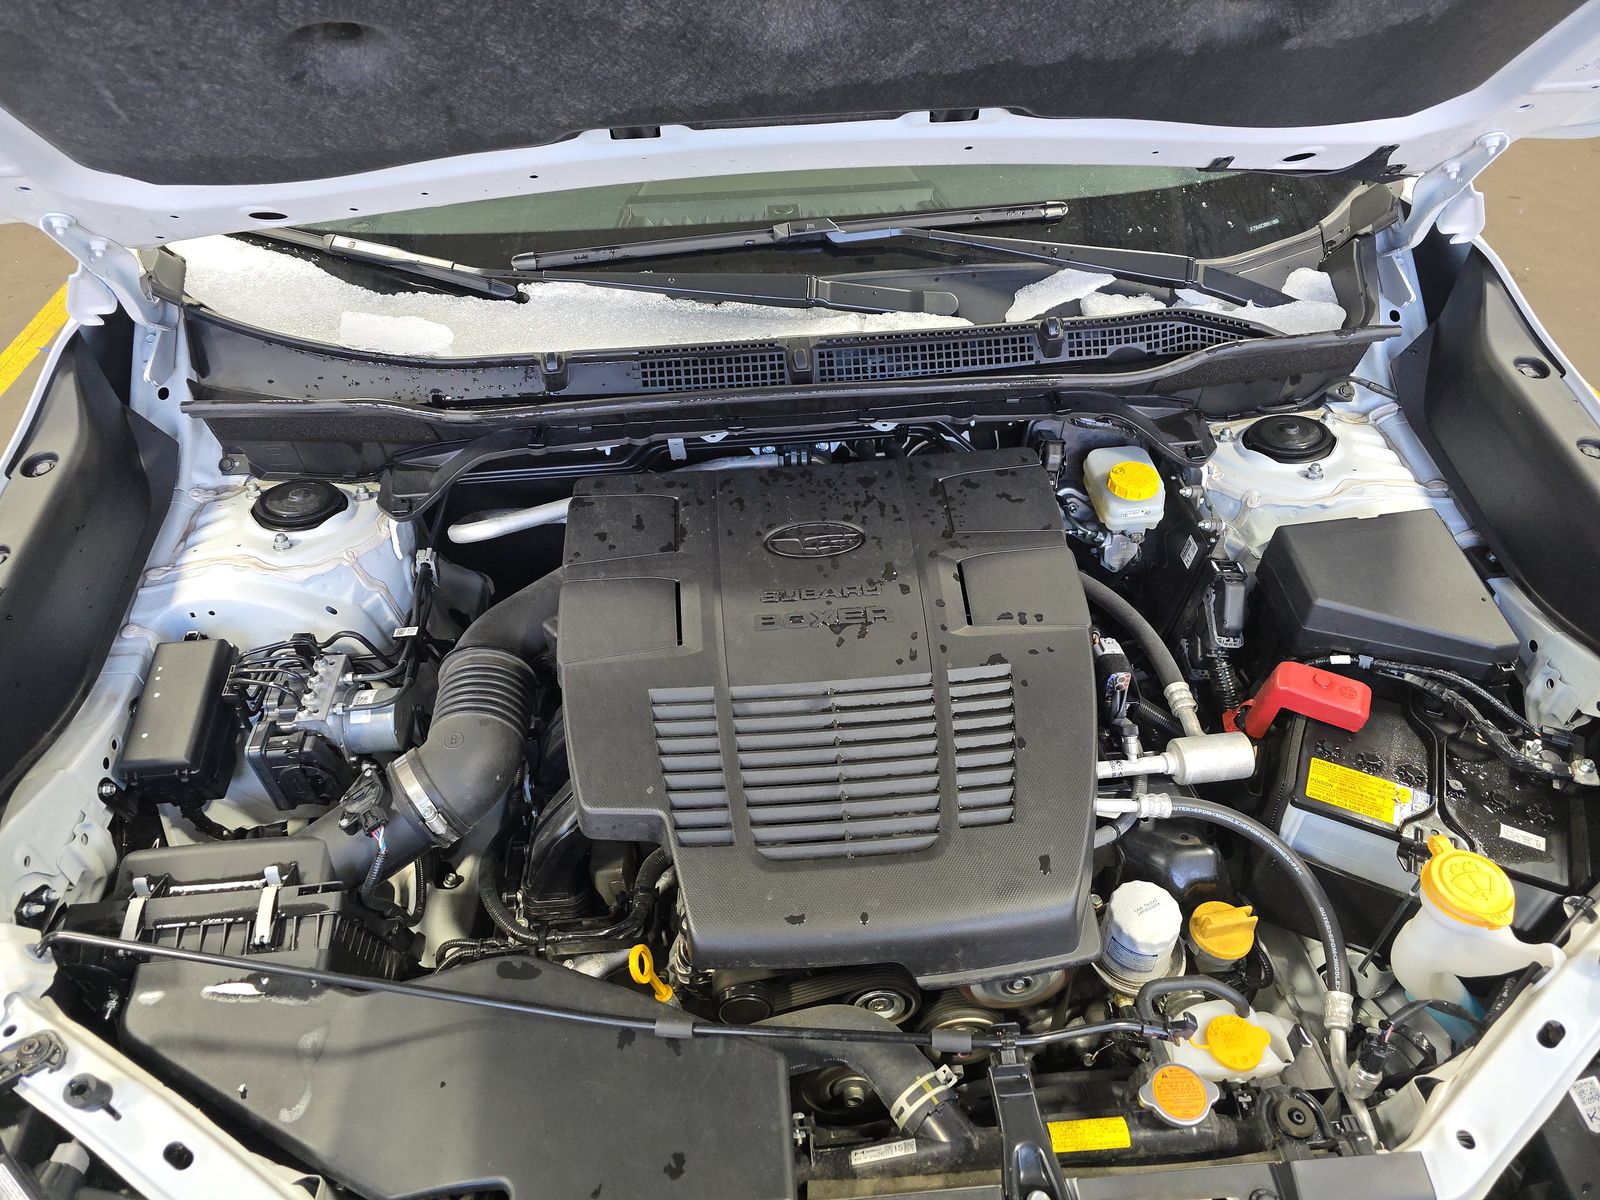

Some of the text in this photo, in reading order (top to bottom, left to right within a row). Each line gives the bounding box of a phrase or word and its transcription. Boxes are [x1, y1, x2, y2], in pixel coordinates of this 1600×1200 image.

[755, 606, 895, 631] BOXER
[1313, 760, 1337, 770] DANGER
[1310, 777, 1334, 788] POISON
